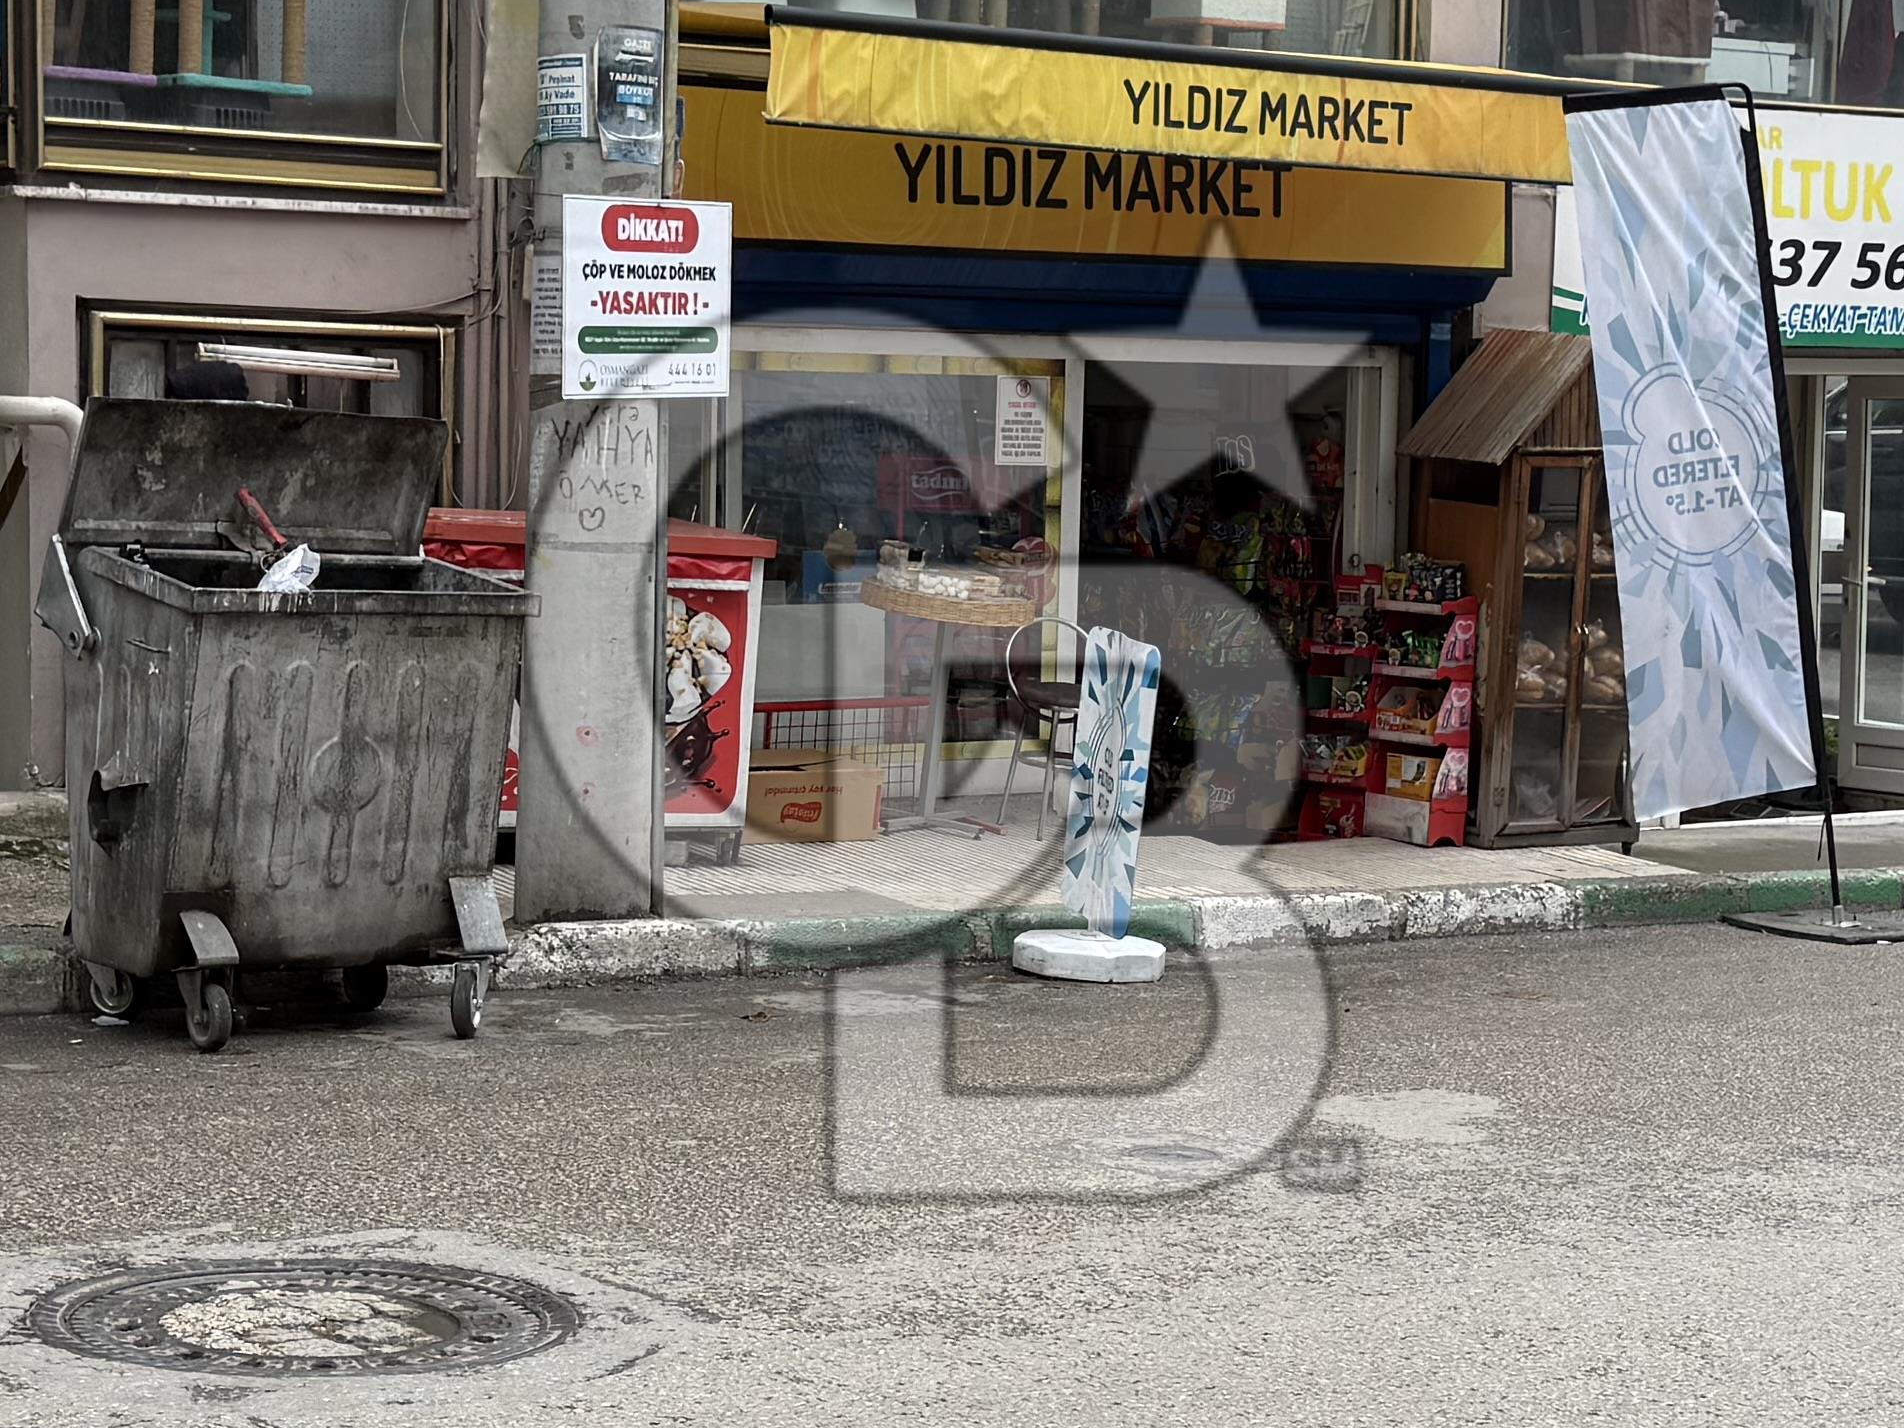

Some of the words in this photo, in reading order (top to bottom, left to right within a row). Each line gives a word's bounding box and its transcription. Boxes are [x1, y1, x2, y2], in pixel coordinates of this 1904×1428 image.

[1123, 78, 1248, 134] YILDIZ
[1258, 92, 1414, 146] MARKET
[894, 141, 1068, 210] YILDIZ
[1084, 149, 1295, 219] MARKET
[1762, 157, 1894, 223] LTUK
[616, 213, 684, 244] DİKKAT!
[581, 258, 608, 282] ÇÖP
[608, 263, 626, 280] VE
[626, 263, 668, 281] MOLOZ
[668, 257, 717, 282] DÖKMEK
[1768, 238, 1842, 287] 37
